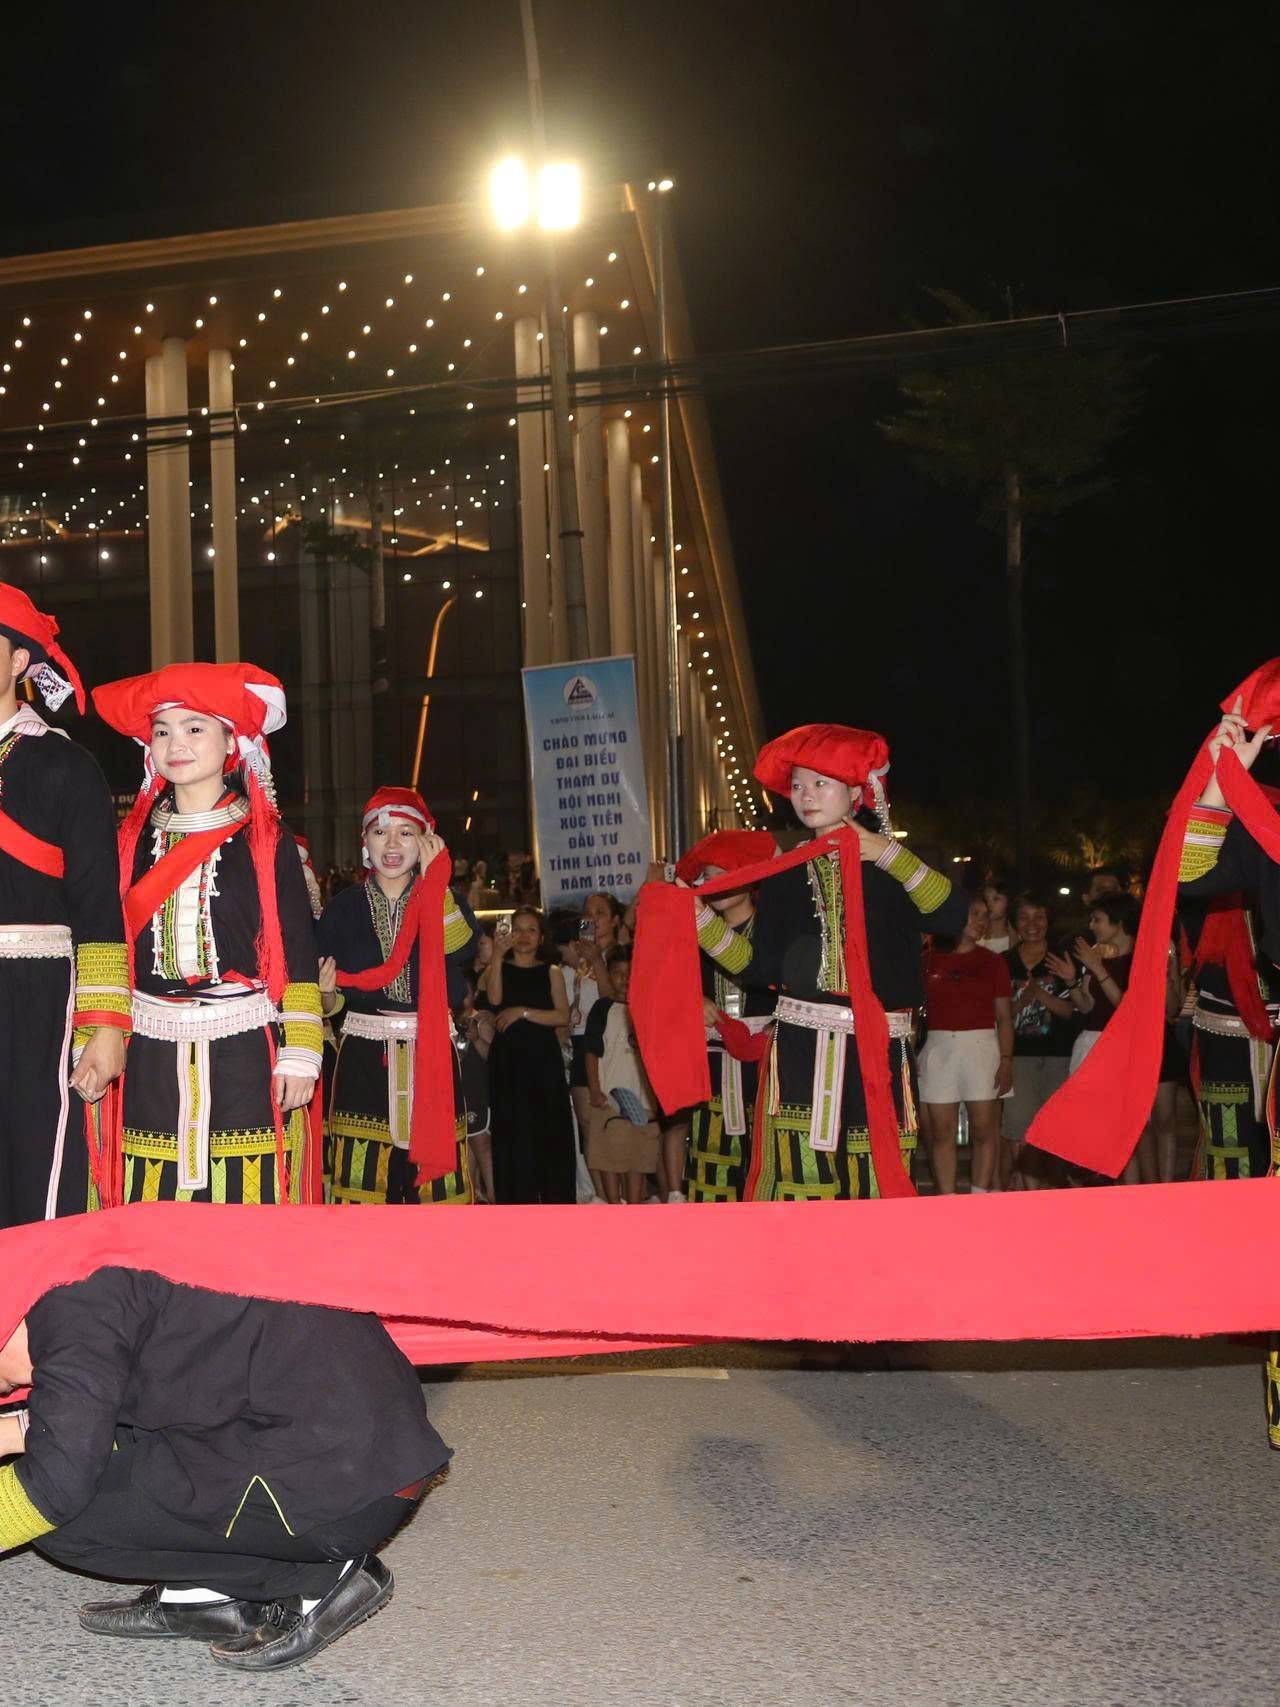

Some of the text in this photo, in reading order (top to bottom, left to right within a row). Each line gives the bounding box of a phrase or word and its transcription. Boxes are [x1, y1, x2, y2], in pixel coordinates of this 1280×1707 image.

[557, 774, 595, 790] THAM
[617, 852, 640, 865] CAI
[598, 873, 632, 887] 2026
